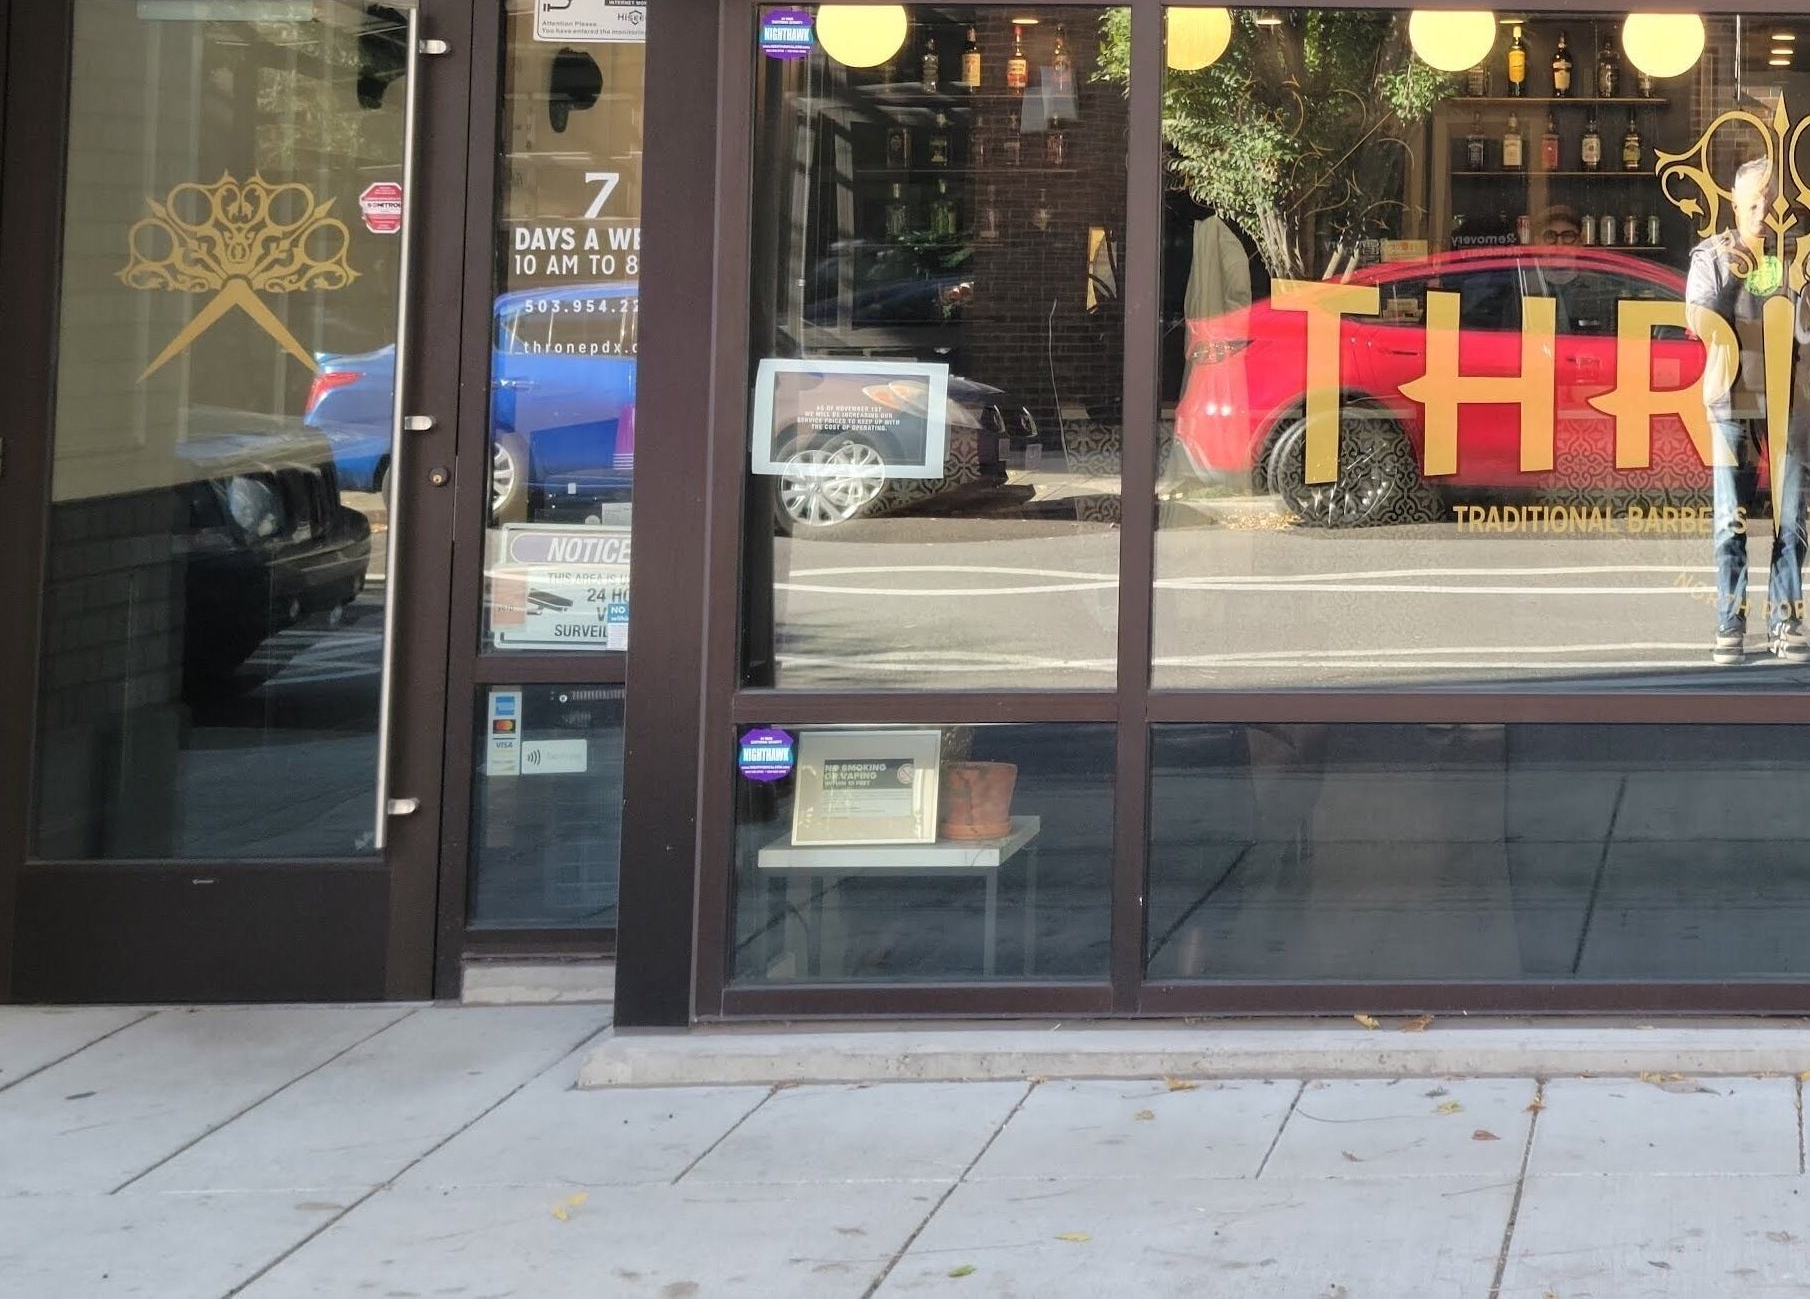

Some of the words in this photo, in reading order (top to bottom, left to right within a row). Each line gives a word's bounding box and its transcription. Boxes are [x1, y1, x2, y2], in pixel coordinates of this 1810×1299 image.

[764, 27, 810, 42] NIGHTHAWK
[583, 172, 620, 219] 7
[514, 227, 576, 251] DAYS
[584, 228, 600, 251] A
[514, 254, 537, 276] 10
[546, 254, 579, 276] AM
[588, 254, 616, 276] TO
[625, 254, 639, 276] 8
[1452, 505, 1620, 533] TRADITIONAL
[1627, 505, 1748, 534] BARBES
[547, 537, 631, 564] NOTICE
[587, 588, 606, 602] 24
[611, 606, 626, 614] NO
[496, 741, 513, 749] VISA
[743, 747, 790, 762] NIGHTHAWK
[841, 763, 887, 771] SMOKING
[840, 771, 878, 780] VAPING
